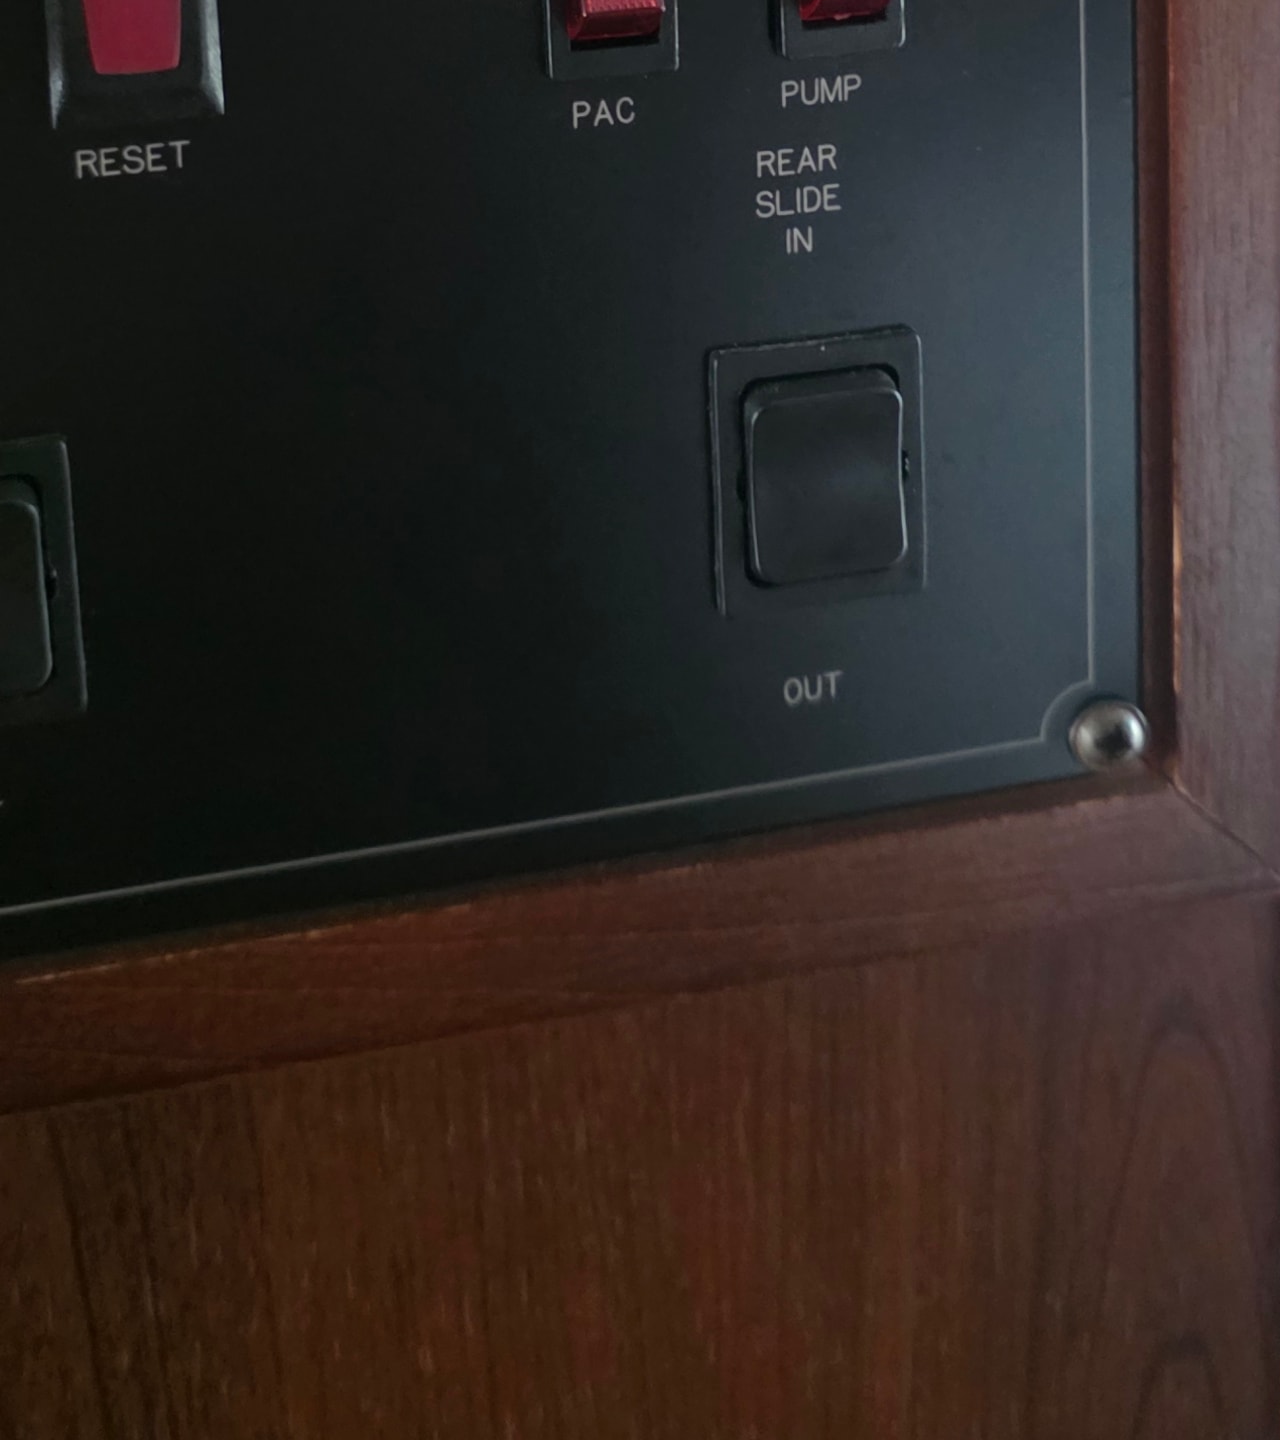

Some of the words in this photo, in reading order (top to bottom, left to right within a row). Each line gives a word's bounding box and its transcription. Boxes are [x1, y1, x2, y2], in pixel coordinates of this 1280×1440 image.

[780, 74, 863, 108] PUMP
[571, 96, 637, 130] PAC
[74, 139, 191, 180] RESET
[756, 143, 838, 179] REAR
[754, 183, 842, 220] SLIDE
[785, 226, 815, 255] IN
[782, 669, 844, 708] OUT
